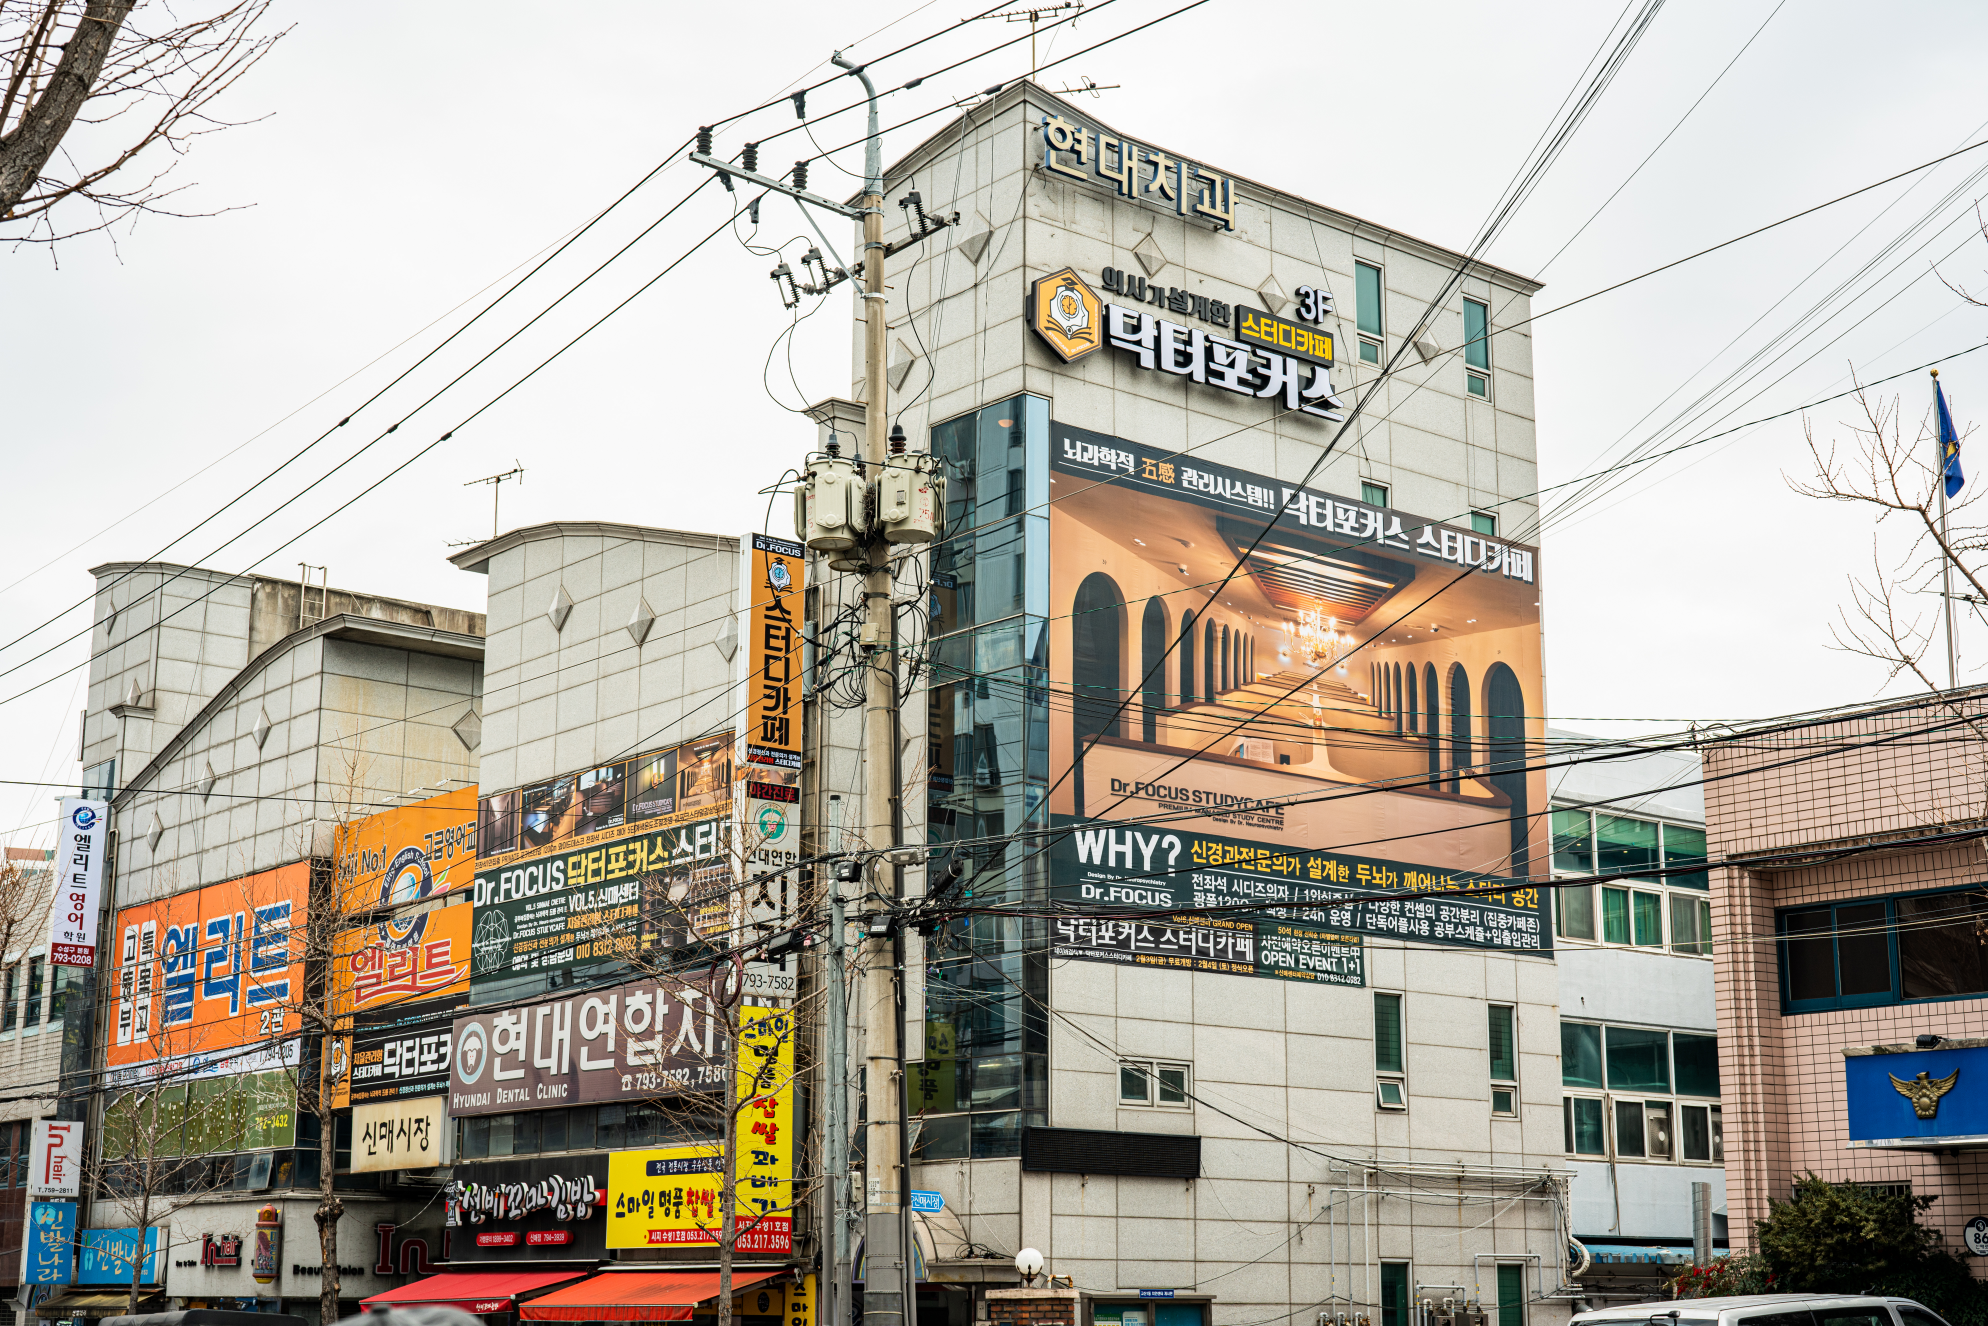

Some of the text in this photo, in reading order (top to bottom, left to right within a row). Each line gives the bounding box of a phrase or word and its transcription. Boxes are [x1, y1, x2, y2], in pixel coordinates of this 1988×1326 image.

[1042, 114, 1240, 231] 현대치과
[1102, 266, 1231, 327] 의사가설계한
[1295, 285, 1334, 323] 3F
[1242, 314, 1332, 361] 스터디카페
[1105, 303, 1345, 422] 닥터포커스
[1063, 438, 1275, 509] 뇌과학적 五感 관리시스템!!
[756, 541, 802, 557] Dr.FOCUS
[1282, 487, 1533, 583] 닥터포커스 스터디카페
[761, 594, 793, 747] 스터디카페
[1111, 778, 1285, 815] Dr.FOCUS STUDYCAFE
[1158, 803, 1194, 812] PREMIUM
[1233, 813, 1256, 822] STUDY
[1257, 817, 1284, 826] CENTRE
[68, 834, 91, 889] 엘리트
[394, 850, 414, 867] English
[1073, 824, 1182, 877] WHY?
[474, 836, 669, 908] Dr.FOCUS 닥터포커스
[1191, 840, 1301, 876] 신경과전문의가
[1307, 857, 1350, 882] 설계한
[1356, 864, 1398, 888] 두뇌가
[1511, 888, 1539, 909] 공간
[1081, 884, 1173, 908] Dr.FOCUS
[1192, 874, 1227, 893] 전좌석
[1232, 879, 1289, 901] 시디즈의자
[1404, 902, 1435, 919] 컨셉의
[1440, 905, 1480, 925] 공간분리
[1484, 911, 1540, 933] (집중카페존)
[513, 928, 536, 939] Dr.FOCUS
[1212, 921, 1253, 931] GRAND OPEN
[1330, 910, 1351, 927] 운영
[1366, 914, 1430, 936] 단독어플사용
[53, 953, 92, 965] 793-0208
[576, 943, 590, 959] 010
[1159, 928, 1254, 961] 스터디카페
[160, 899, 293, 1026] 엘리트
[350, 938, 468, 1006] 엘리트
[1168, 957, 1192, 967] 무료개방
[1198, 960, 1217, 970] 2월4일
[1261, 950, 1360, 974] OPEN EVENT 1+1
[743, 973, 795, 992] 793-7582
[259, 1008, 285, 1036] 2관
[492, 984, 726, 1081] 현대연합치
[744, 1016, 789, 1043] 스마일
[352, 1064, 382, 1080] 스터디카페
[453, 1083, 568, 1109] HYUNDAI DENTAL CLINIC
[751, 1094, 779, 1145] 찹쌀
[362, 1115, 431, 1156] 신매시장
[52, 1155, 67, 1183] hair
[656, 1162, 666, 1173] 전국
[668, 1160, 689, 1173] 전통시장
[462, 1174, 598, 1224] 선비꼬마김밥
[615, 1189, 654, 1219] 스마일
[659, 1187, 683, 1219] 명품
[686, 1187, 715, 1218] 찹쌀
[651, 1230, 722, 1242] 시지 수성1호점 053.217.359
[754, 1219, 789, 1232] 수성1호점
[37, 1211, 64, 1282] 신발나라
[220, 1235, 238, 1256] hair
[737, 1233, 789, 1249] 053.217.3596
[292, 1264, 322, 1275] Beau
